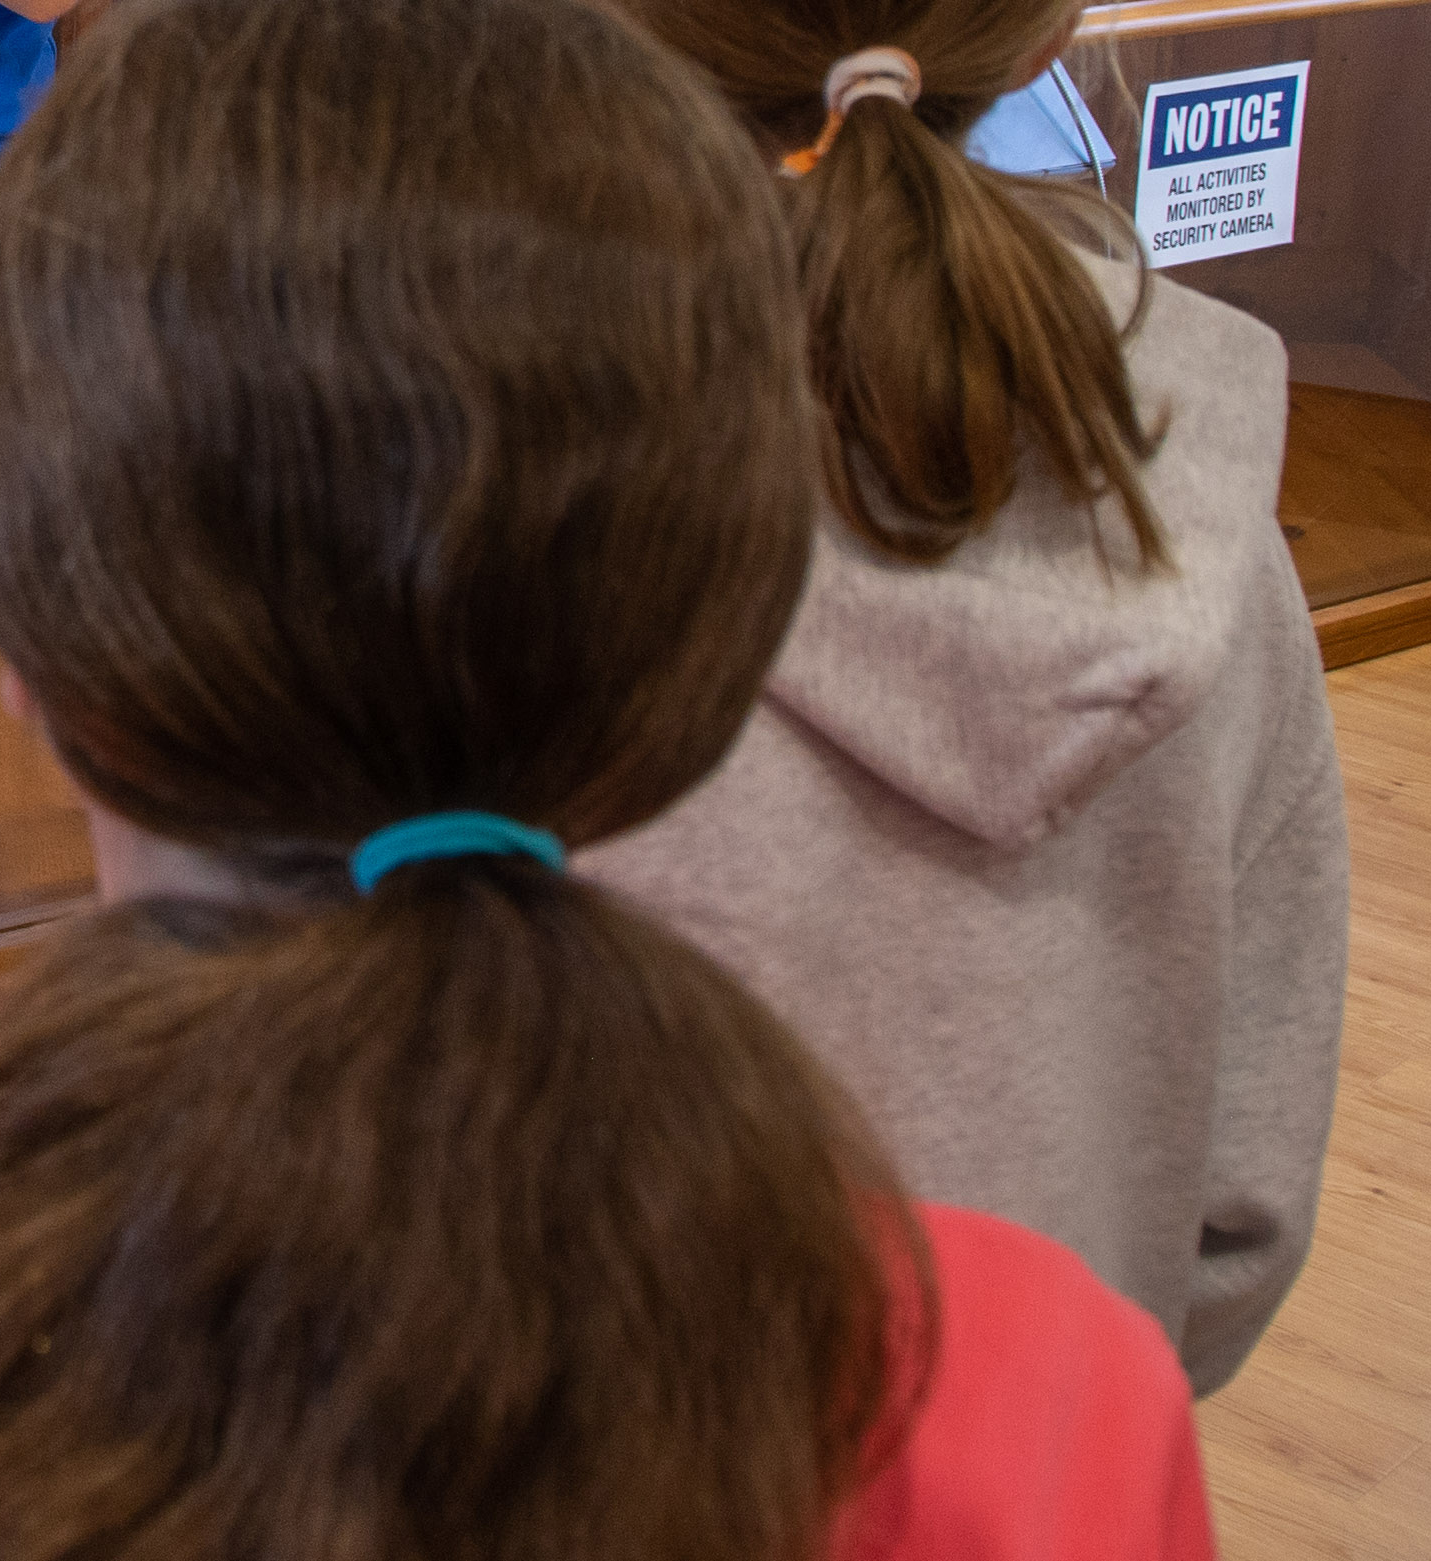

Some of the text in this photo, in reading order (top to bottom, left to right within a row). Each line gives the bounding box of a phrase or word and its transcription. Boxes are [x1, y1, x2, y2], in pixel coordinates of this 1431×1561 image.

[1163, 91, 1285, 156] NOTICE
[1168, 163, 1267, 197] ALL ACTIVITIES
[1166, 188, 1265, 223] MONITORED BY
[1153, 212, 1275, 252] SECURITY CAMERA
